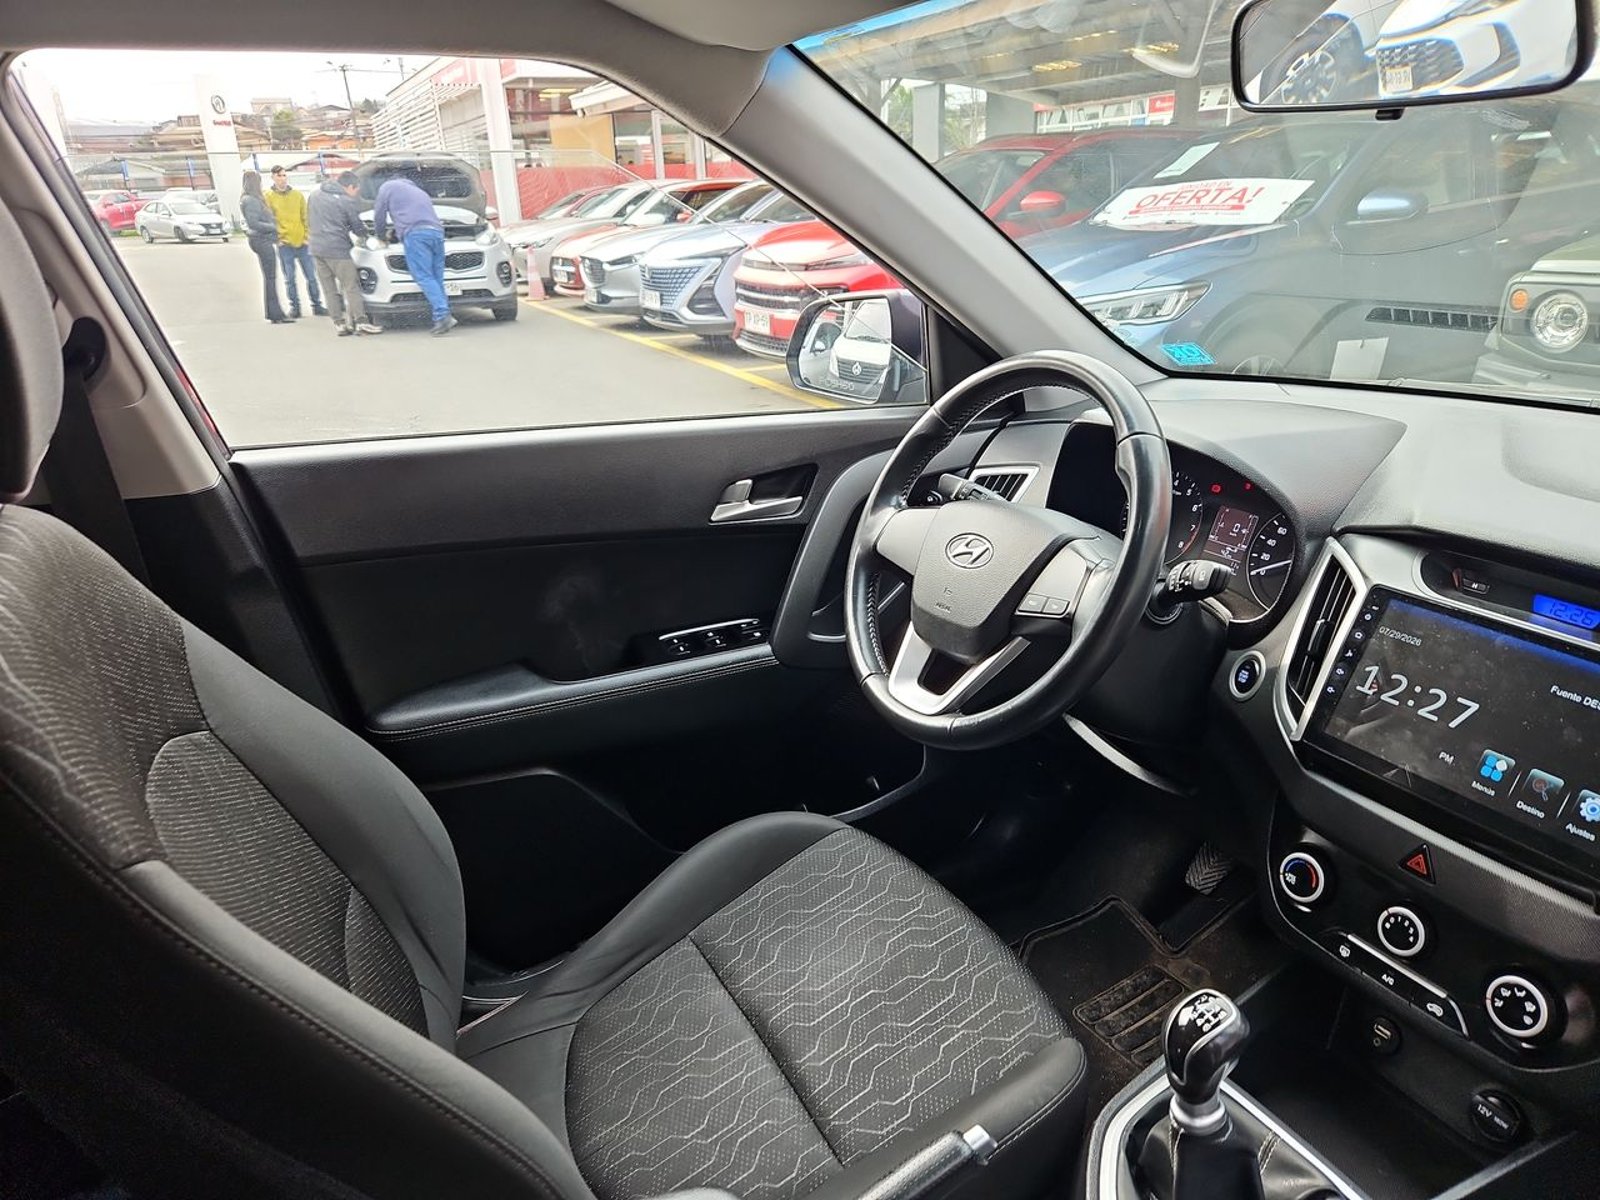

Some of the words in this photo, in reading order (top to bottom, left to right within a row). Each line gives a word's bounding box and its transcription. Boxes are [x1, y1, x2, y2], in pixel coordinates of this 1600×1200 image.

[1136, 187, 1264, 208] OFERTA!
[1191, 504, 1199, 513] 6
[1189, 523, 1197, 532] 7
[1276, 526, 1288, 536] 60
[1266, 538, 1277, 548] 40
[1260, 552, 1271, 562] 20
[1356, 665, 1480, 729] 12:27
[1550, 685, 1582, 703] Fuente
[1439, 751, 1454, 765] PM
[1516, 800, 1545, 819] Destino
[1566, 822, 1596, 842] Ajustes
[1477, 1103, 1493, 1118] 12V
